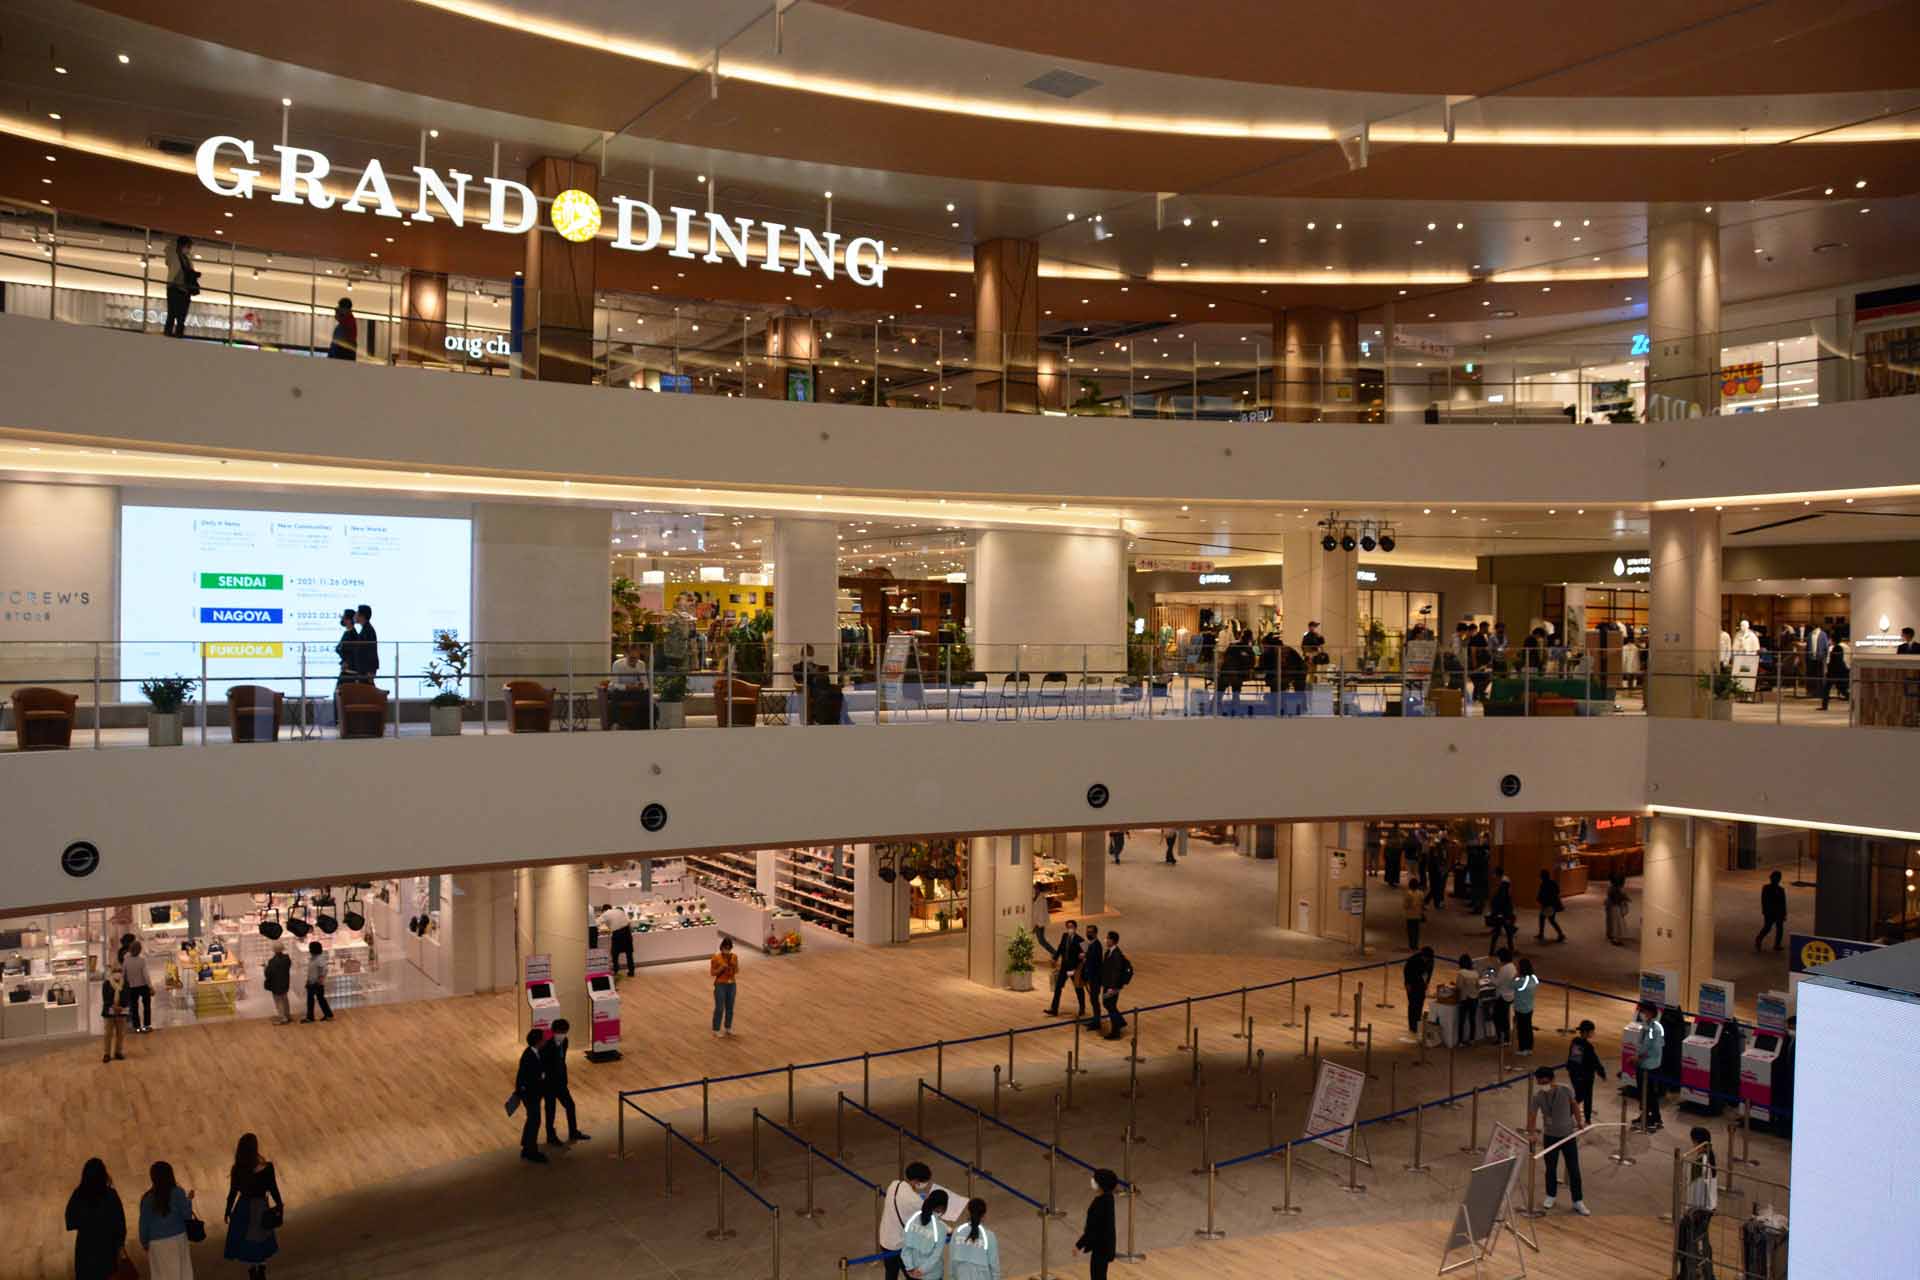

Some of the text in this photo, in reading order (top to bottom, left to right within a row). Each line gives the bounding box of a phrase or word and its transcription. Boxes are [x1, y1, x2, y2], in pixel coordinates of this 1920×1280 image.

[195, 135, 538, 234] GRAND
[610, 196, 888, 288] DINING
[218, 576, 267, 588] SENDAI
[213, 611, 271, 622] NAGOYA
[209, 644, 274, 656] FUKUOKA
